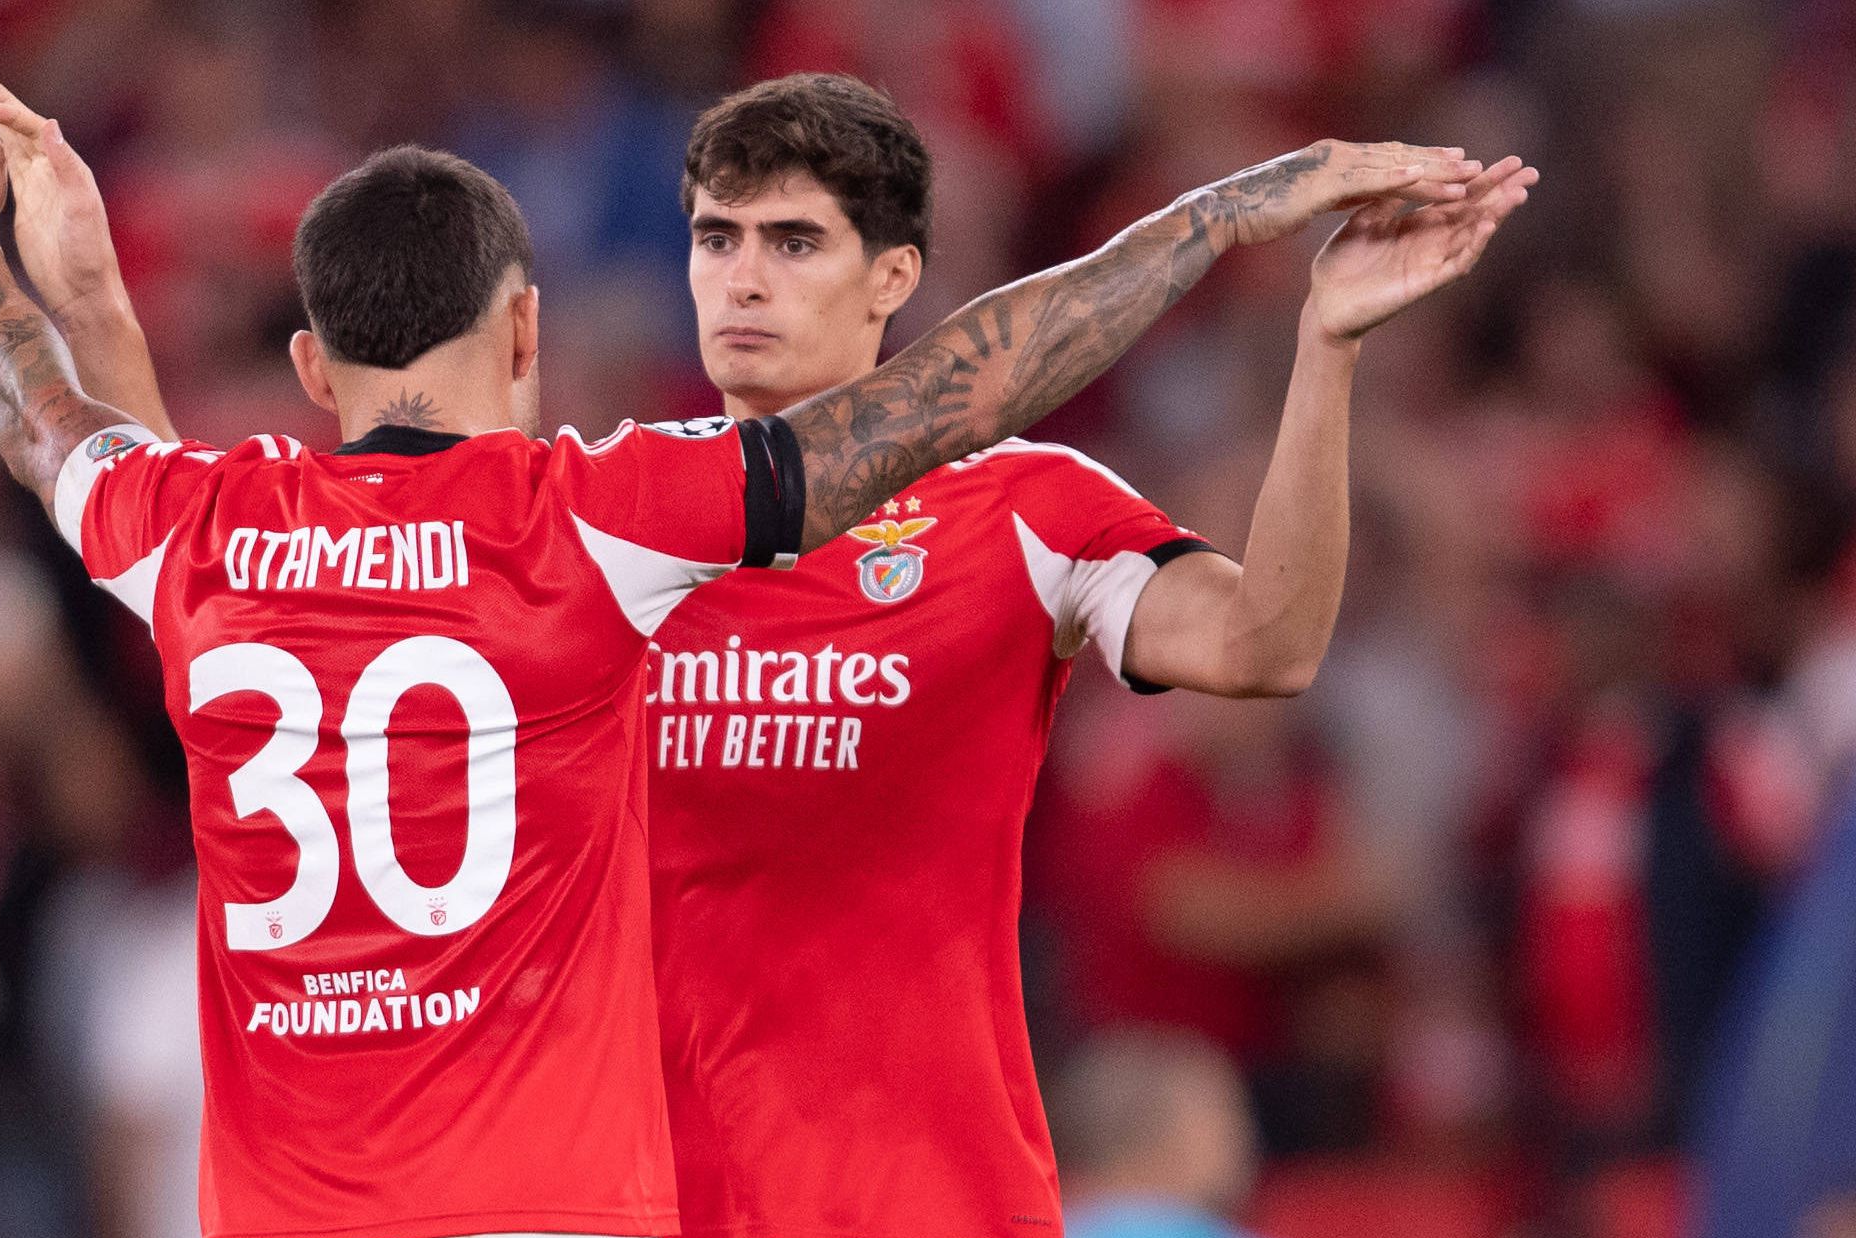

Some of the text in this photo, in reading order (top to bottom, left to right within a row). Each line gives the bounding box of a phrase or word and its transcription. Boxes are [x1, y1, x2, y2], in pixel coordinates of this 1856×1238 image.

[224, 520, 469, 591] OTAMENDI
[659, 714, 862, 769] FLY BETTER
[188, 635, 519, 952] 30
[303, 967, 407, 997] BENFICA
[246, 984, 481, 1036] FOUNDATION
